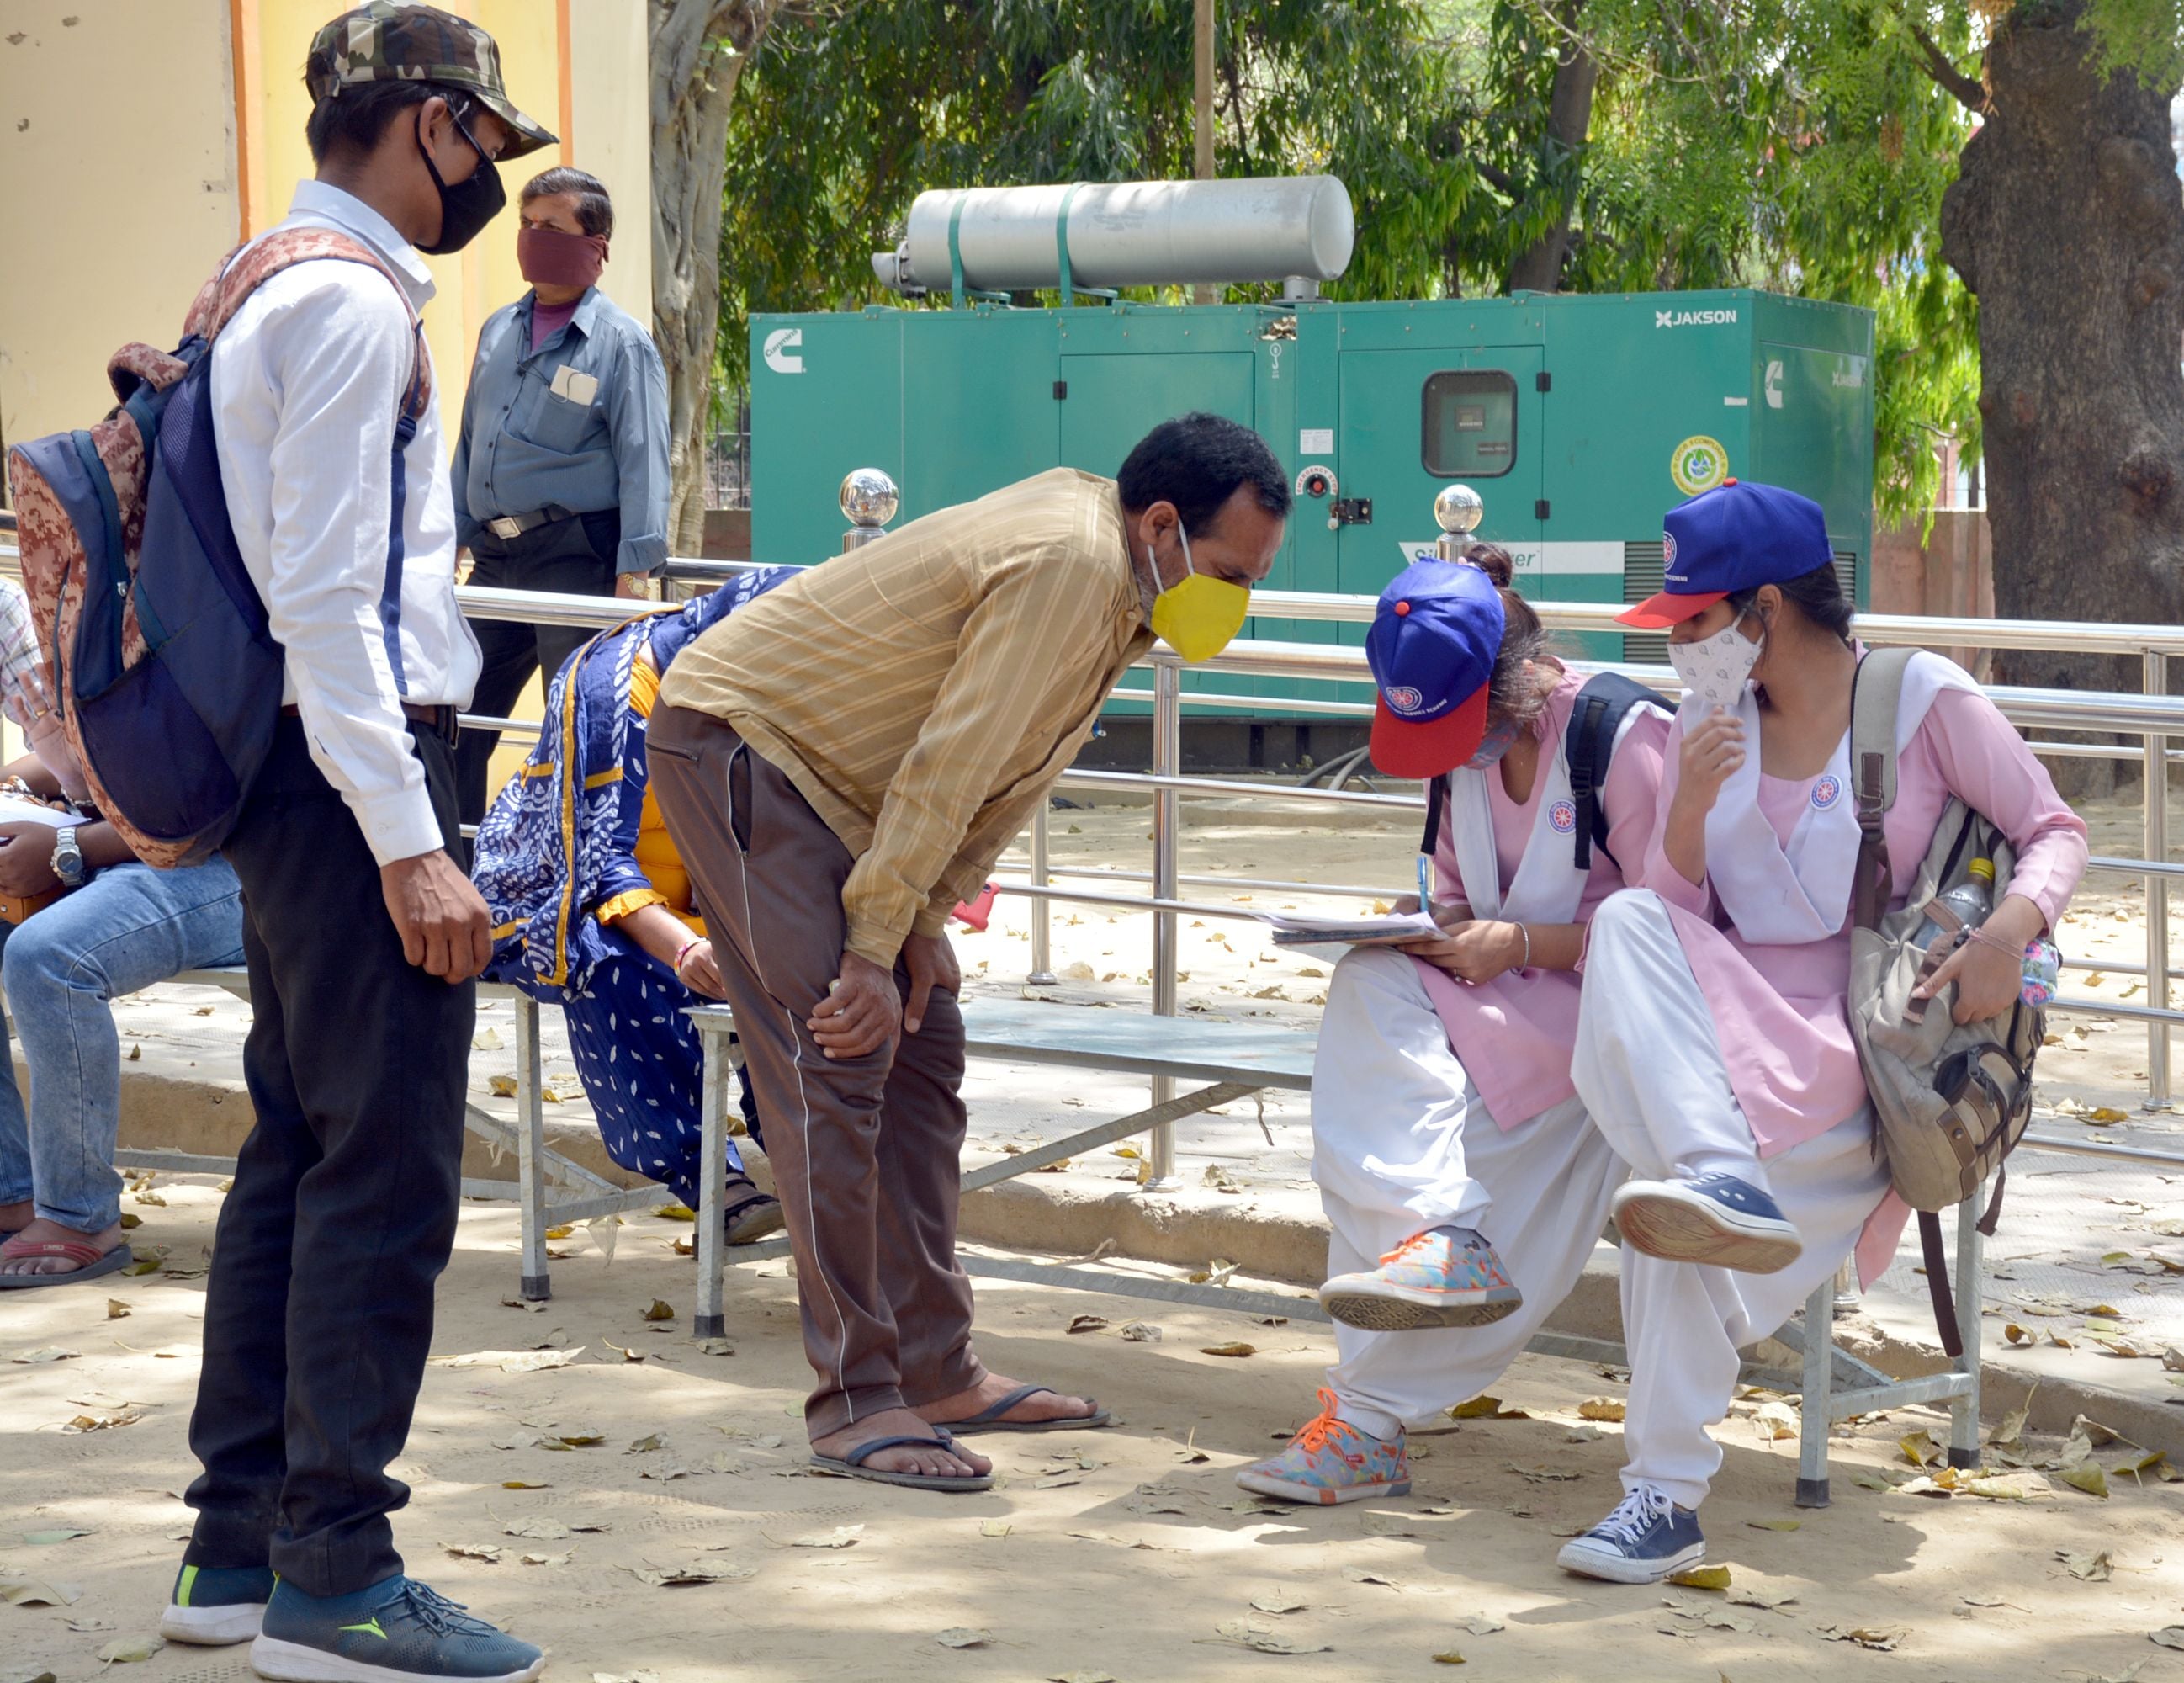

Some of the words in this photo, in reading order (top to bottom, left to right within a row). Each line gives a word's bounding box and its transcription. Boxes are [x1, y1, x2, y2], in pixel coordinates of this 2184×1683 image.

[1672, 309, 1737, 326] JAKSON
[766, 329, 798, 358] Cummins
[1694, 438, 1725, 459] COMPLIANT
[1296, 467, 1328, 494] EMERGENCY
